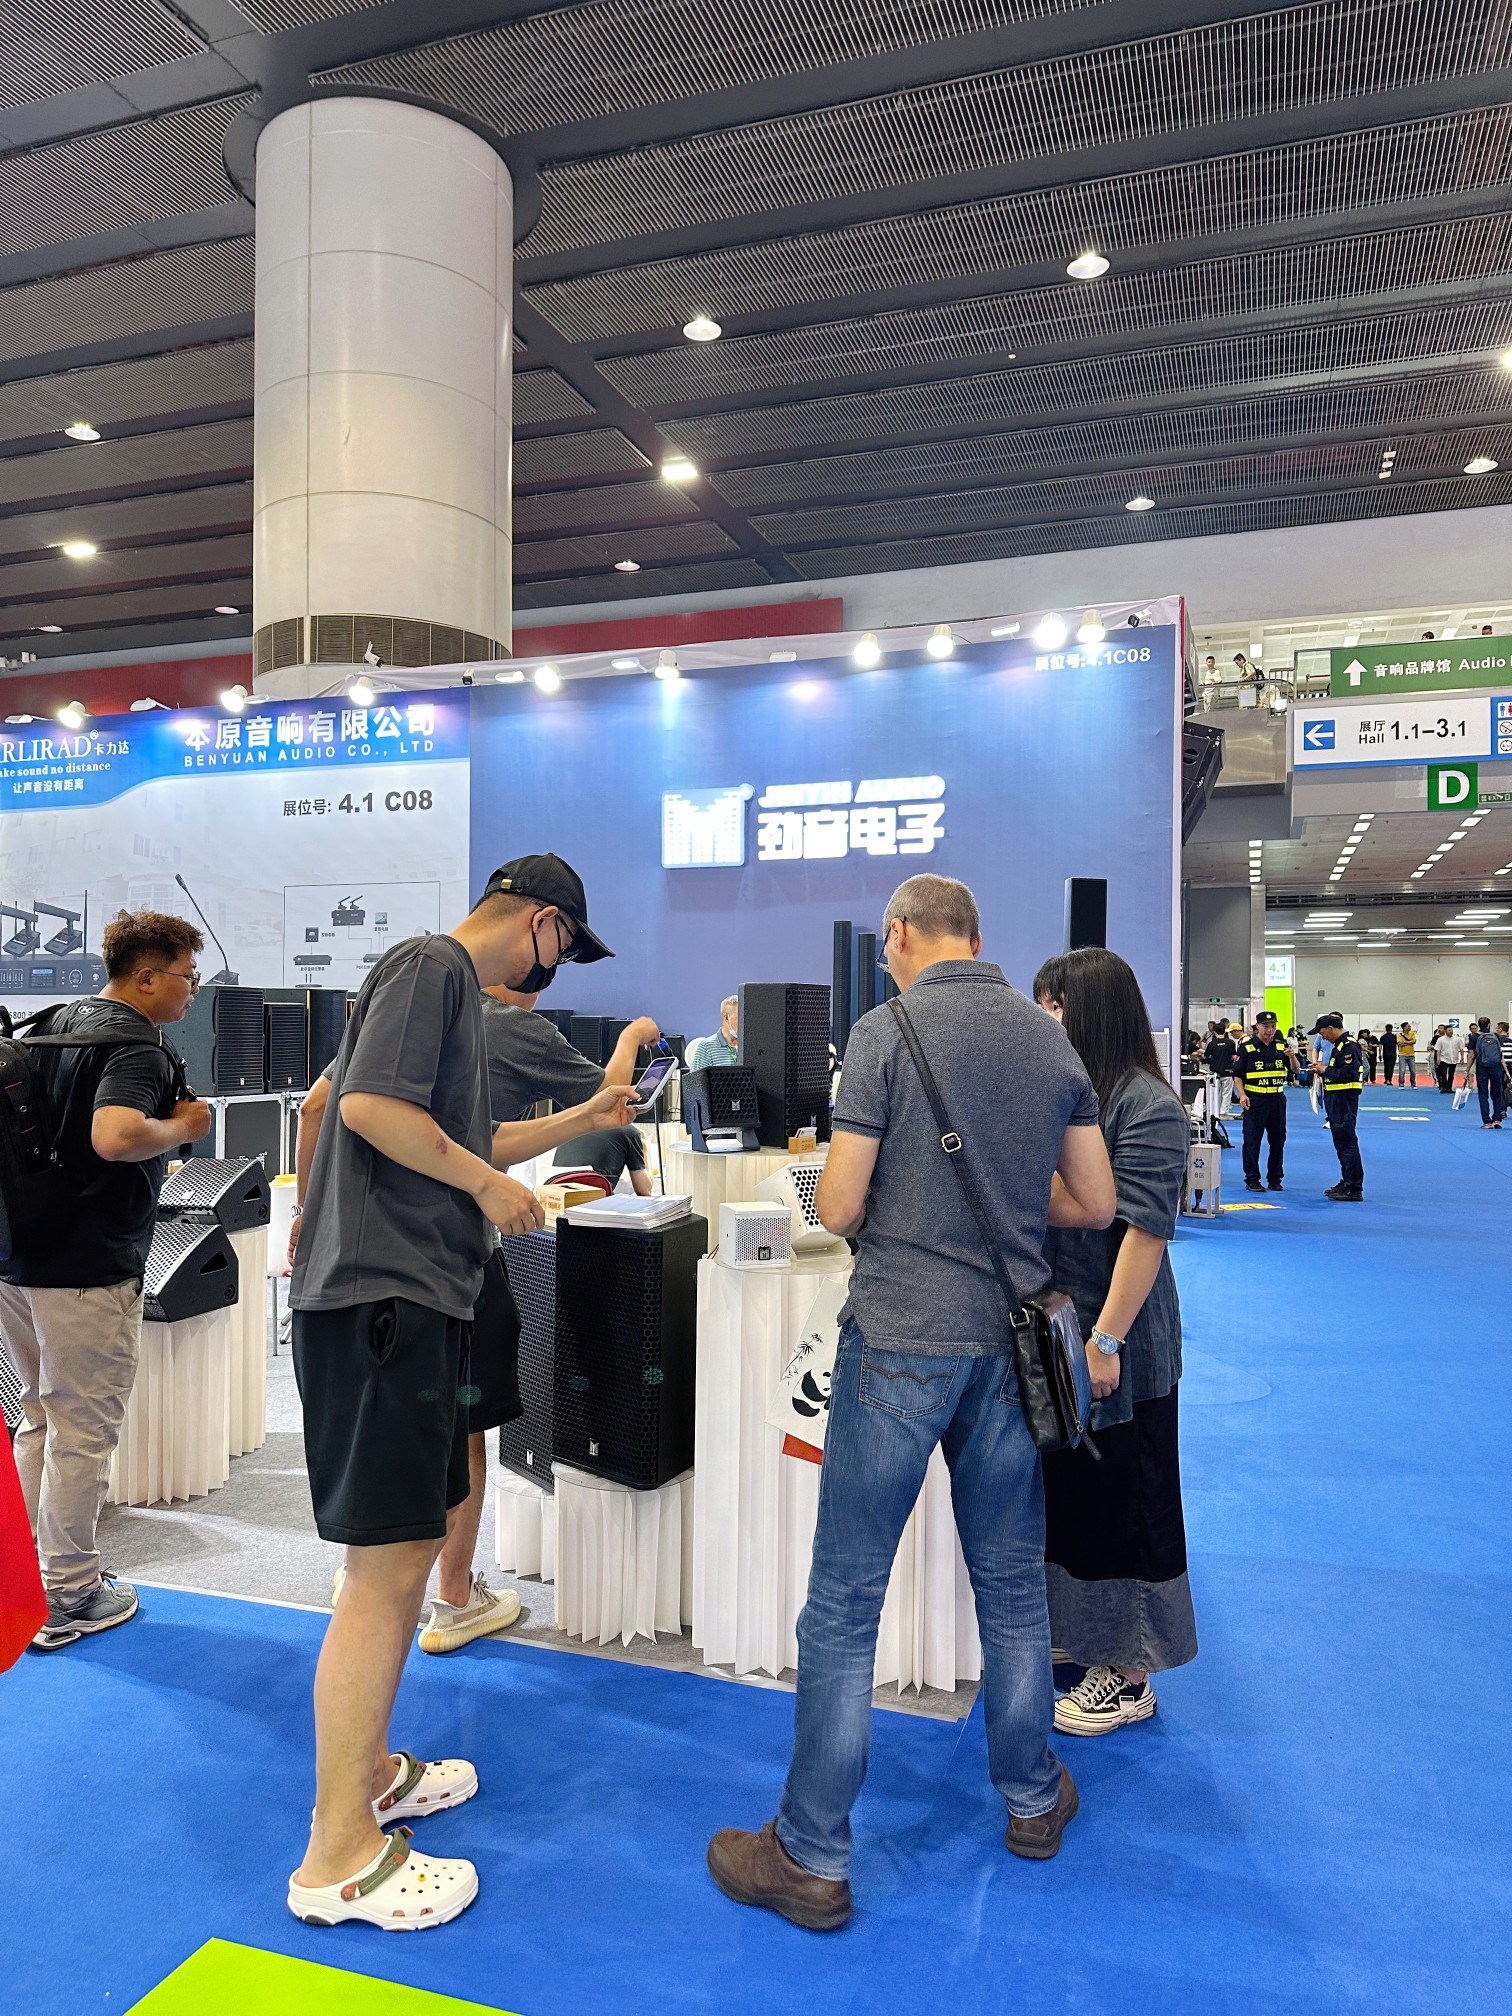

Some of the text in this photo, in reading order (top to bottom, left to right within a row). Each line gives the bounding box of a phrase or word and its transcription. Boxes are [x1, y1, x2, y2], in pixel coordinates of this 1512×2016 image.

[1373, 659, 1452, 678] 音响品牌馆
[1458, 656, 1506, 671] Audio
[184, 703, 435, 752] 本原音响有限公司
[1359, 719, 1386, 732] 展厅
[93, 740, 130, 757] 卡力达
[1358, 733, 1384, 744] Hall
[184, 740, 435, 768] BENYUAN AUDIO CO., LTD
[0, 761, 111, 778] ake sound no distance
[12, 778, 85, 794] 让声音没有距离
[855, 776, 945, 802] AUDIO
[1438, 769, 1470, 805] D
[338, 792, 374, 813] 4.1
[385, 789, 433, 812] C08
[758, 804, 945, 860] 劲音电子
[1269, 963, 1286, 973] 4.1
